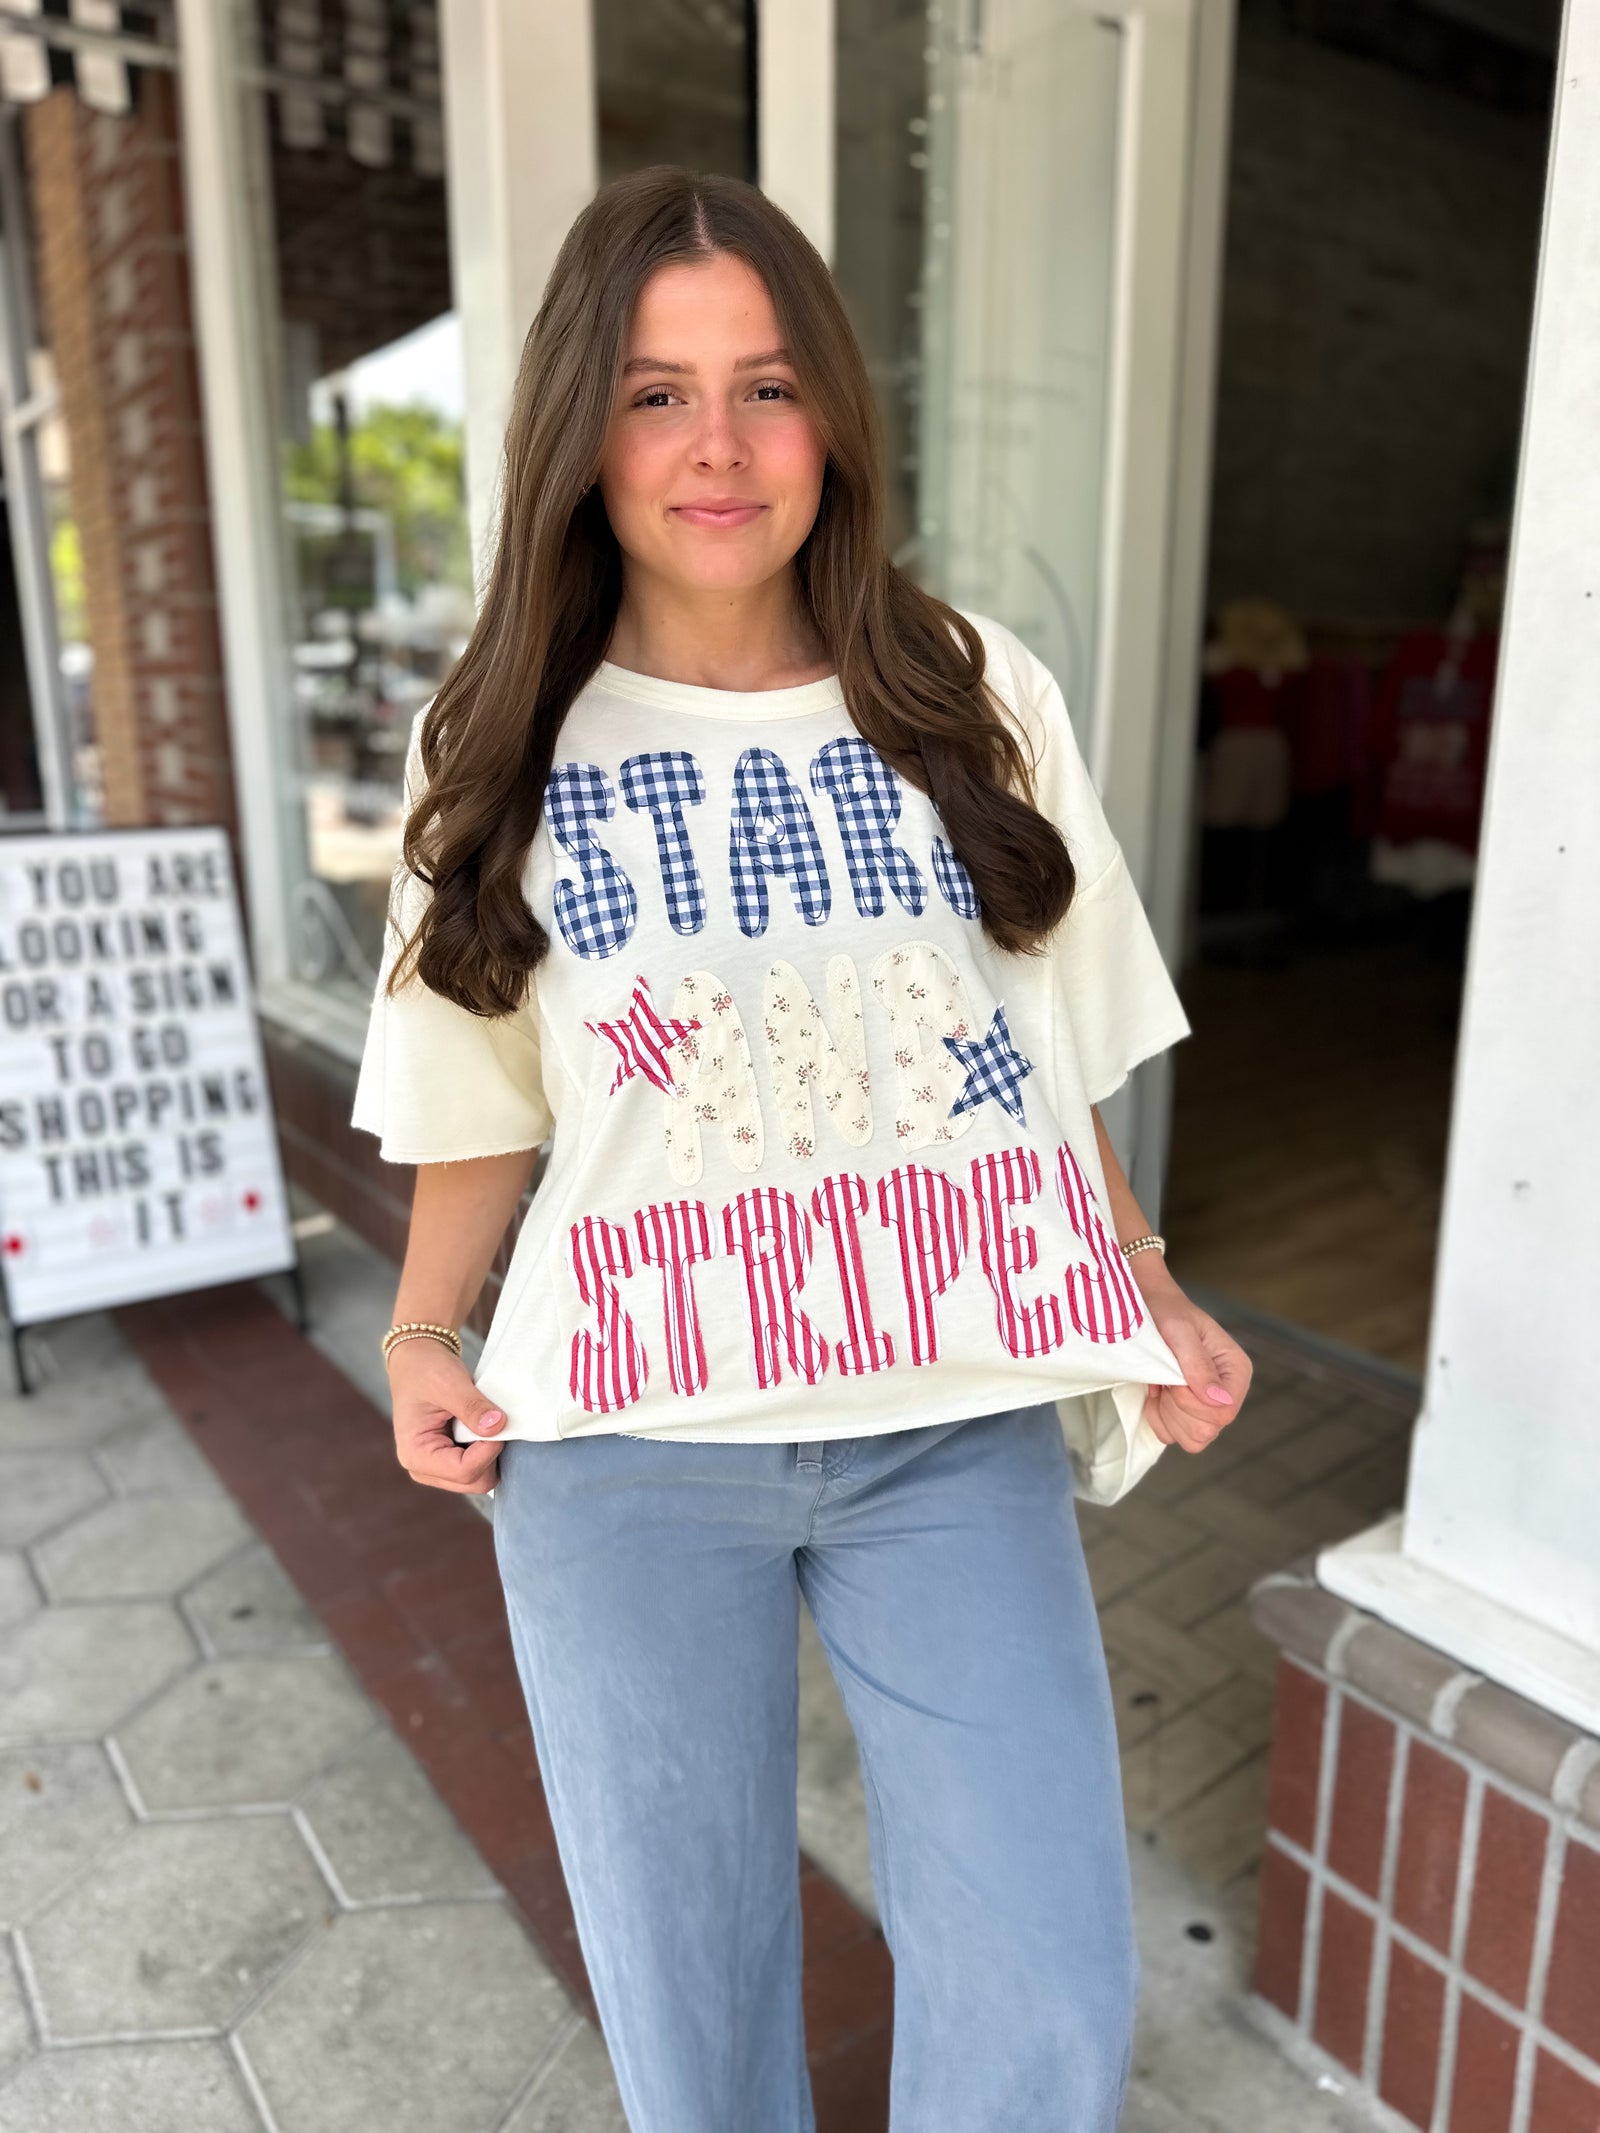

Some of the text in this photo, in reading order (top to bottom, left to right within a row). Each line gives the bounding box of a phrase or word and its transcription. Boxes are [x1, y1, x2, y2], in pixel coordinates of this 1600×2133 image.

[26, 850, 224, 908] YOU ARE
[0, 907, 203, 971] OOKING
[86, 974, 114, 1021] A
[129, 963, 237, 1017] SIGN
[48, 1024, 190, 1084] TO GO
[664, 941, 979, 1188] AND
[0, 1071, 259, 1149] SHOPPING
[43, 1130, 226, 1202] THIS IS
[136, 1193, 186, 1247] IT
[566, 1140, 1145, 1413] STRIPES
